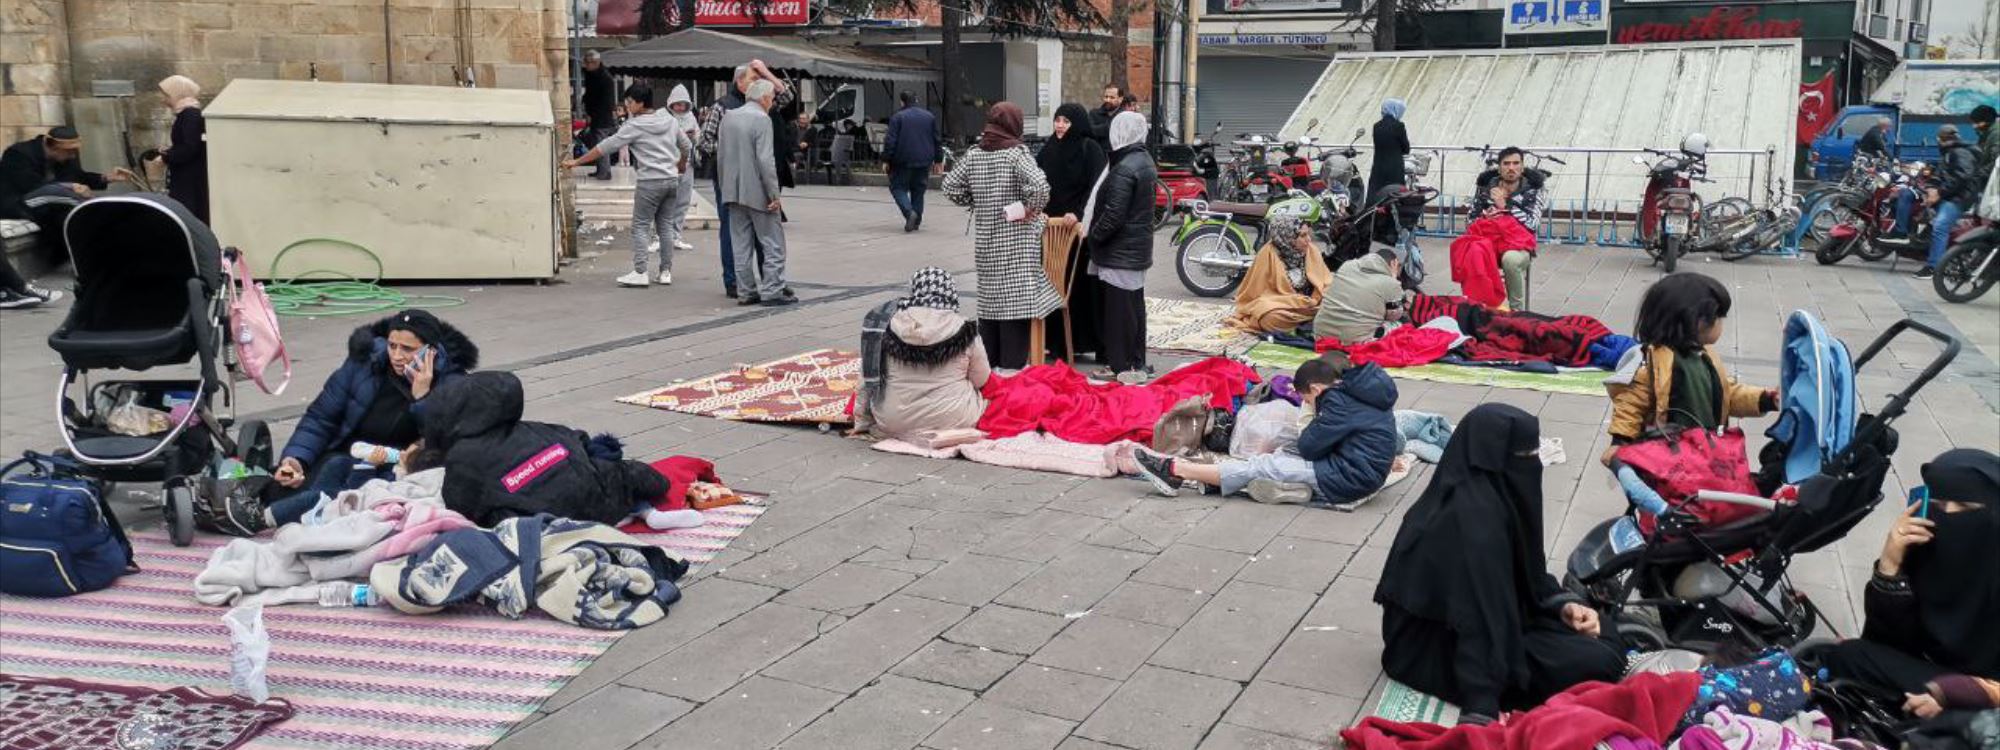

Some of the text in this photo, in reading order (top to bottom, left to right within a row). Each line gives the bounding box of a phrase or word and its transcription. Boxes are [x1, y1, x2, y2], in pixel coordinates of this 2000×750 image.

[1200, 35, 1230, 45] ABAM
[506, 447, 565, 487] Speed running
